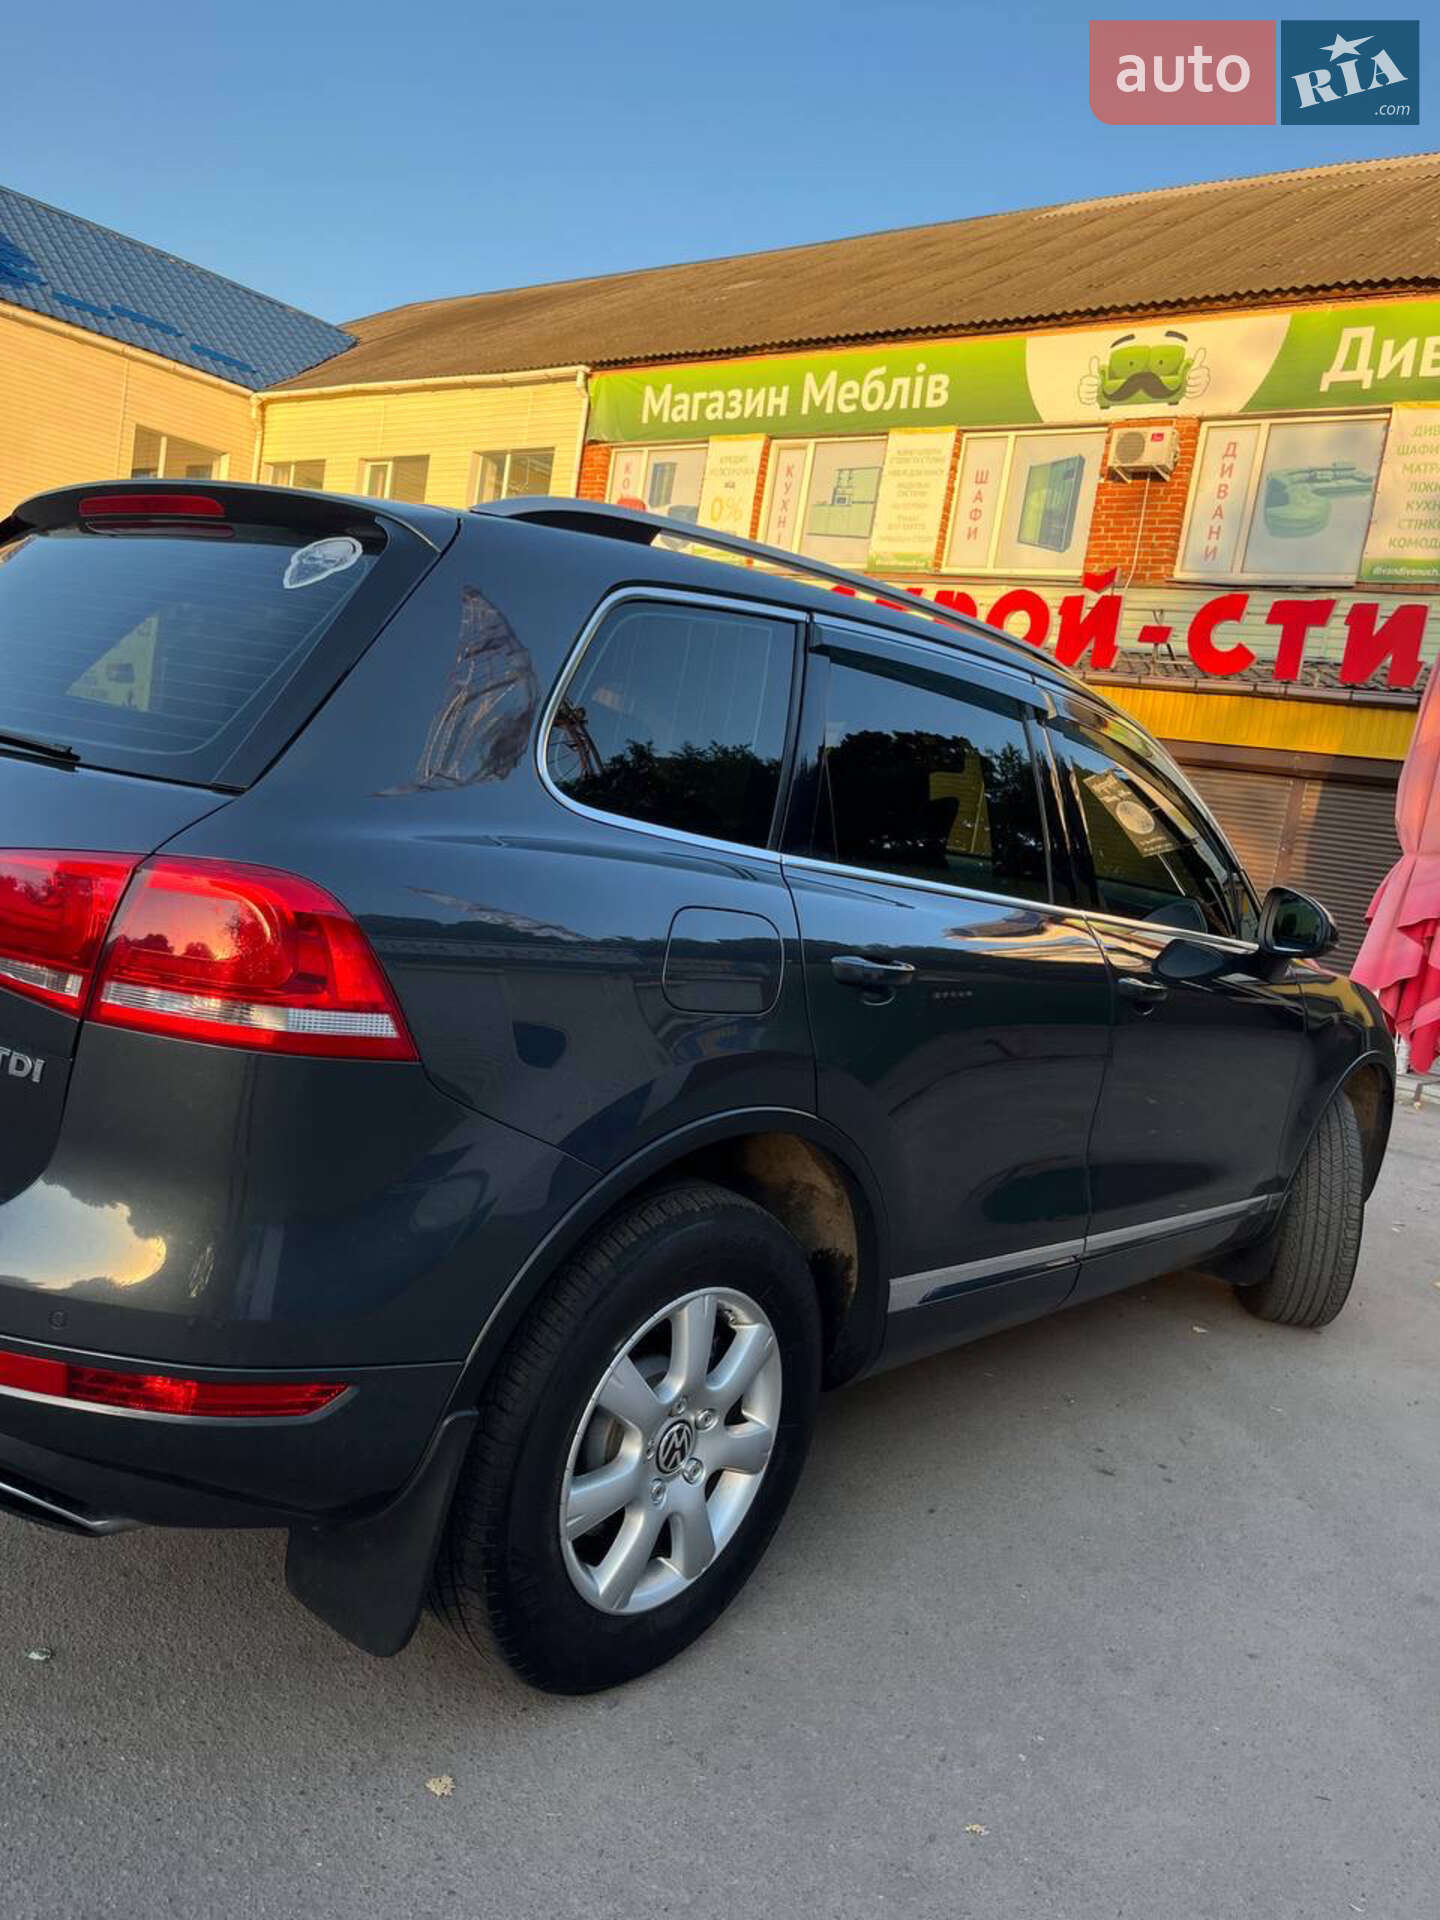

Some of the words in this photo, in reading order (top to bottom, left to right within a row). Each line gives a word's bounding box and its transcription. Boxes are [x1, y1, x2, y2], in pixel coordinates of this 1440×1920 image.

[641, 384, 789, 424] Магазин
[801, 363, 950, 415] Меблів
[777, 464, 794, 544] КУХНІ
[967, 469, 990, 541] ШАФИ
[1203, 441, 1237, 561] ДИВАНИ
